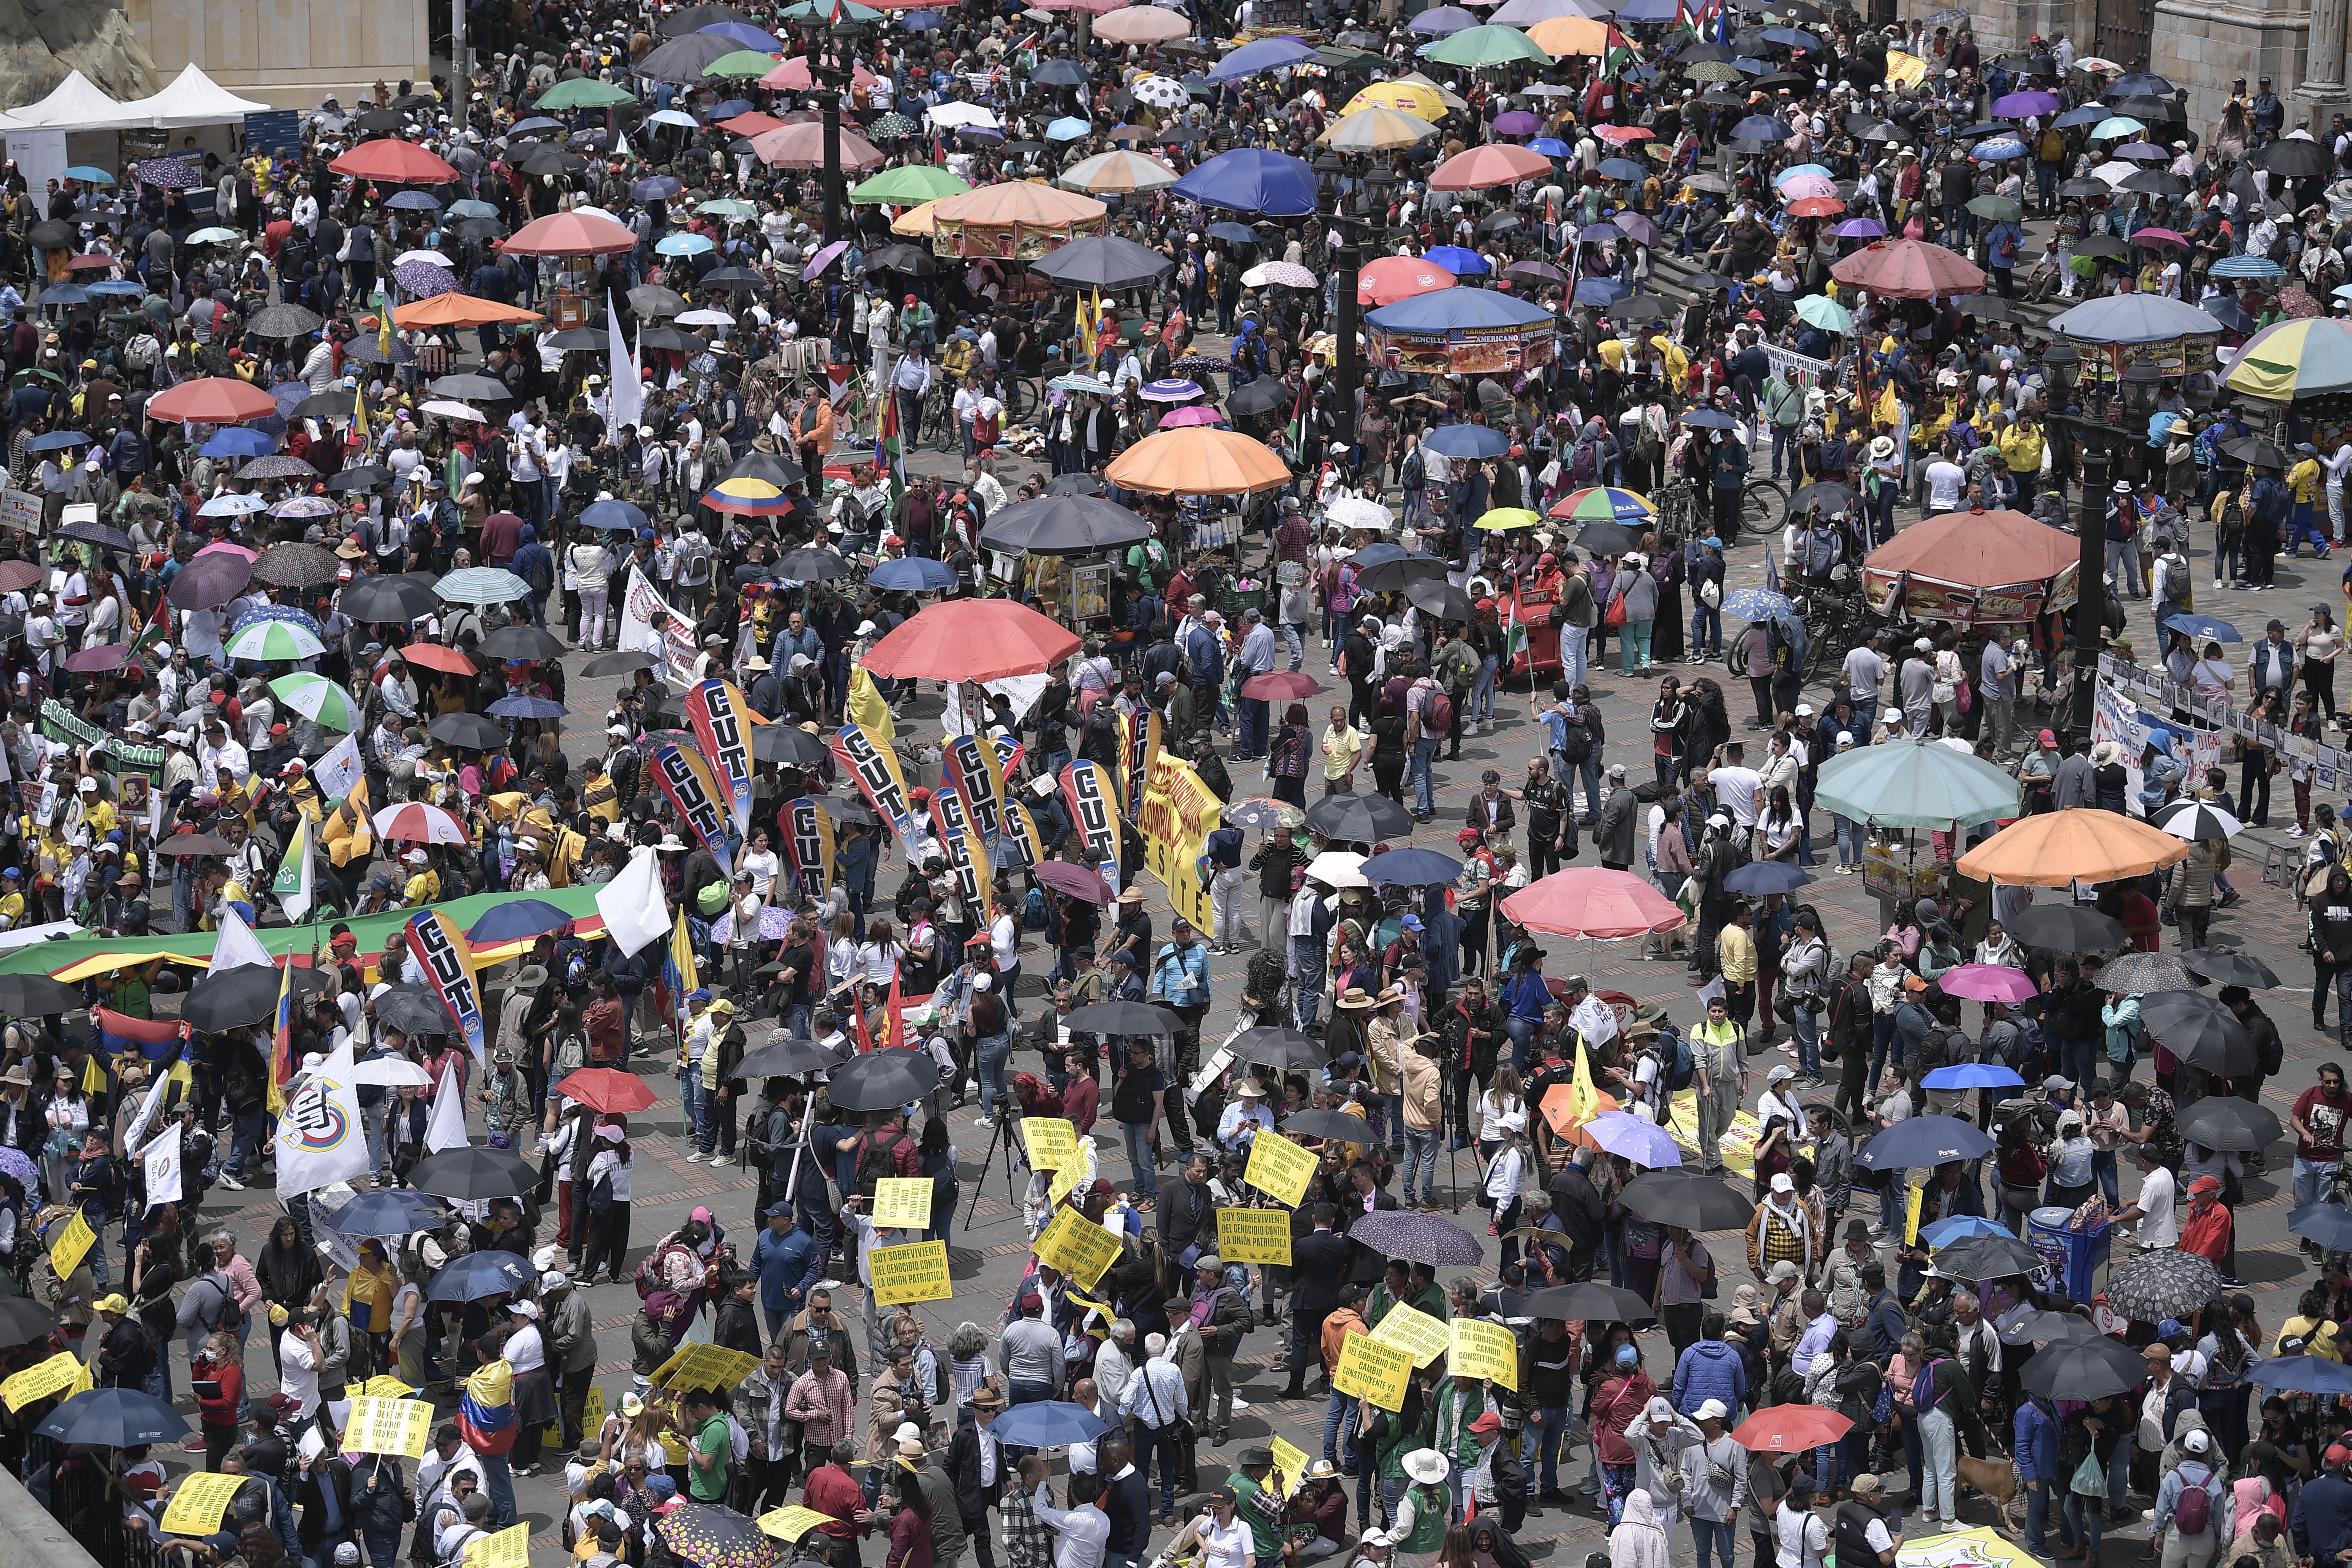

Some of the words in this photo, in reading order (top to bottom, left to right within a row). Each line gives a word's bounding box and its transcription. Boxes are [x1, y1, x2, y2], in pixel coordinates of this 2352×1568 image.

[133, 141, 156, 149] CAMBIO
[1475, 335, 1518, 343] AMERICANO
[1520, 331, 1533, 339] SUPER
[1533, 328, 1554, 337] ESPECIAL
[1758, 344, 1795, 364] OVIMIENTO
[13, 501, 24, 511] 13
[706, 685, 748, 781] CUT
[844, 729, 907, 822] CUT
[664, 751, 720, 838] CUT
[956, 741, 999, 834] CUT
[1074, 766, 1116, 865] CUT
[1137, 795, 1171, 847] OLOMBIA
[1004, 803, 1037, 868] CU
[792, 806, 826, 897] CUT
[417, 915, 474, 1017] CUT
[294, 1089, 329, 1130] CUT
[1036, 1148, 1073, 1156] CONSTITUYENTE
[1274, 1150, 1296, 1167] GOBIERNO
[1296, 1163, 1304, 1172] DEL
[1278, 1141, 1287, 1151] LAS
[1286, 1144, 1311, 1163] REFORMAS
[1938, 1148, 1959, 1157] Parker
[1261, 1163, 1291, 1186] CONSTITUYENTE
[1290, 1181, 1297, 1190] YA
[1273, 1160, 1290, 1174] CAMBIO
[890, 1181, 900, 1210] CONSTITUYENTE
[901, 1190, 909, 1206] CAMBIO
[910, 1188, 919, 1209] GOBIERNO
[918, 1195, 928, 1221] REFORMAS
[1222, 1212, 1234, 1222] SOY
[1236, 1213, 1286, 1225] SOBREVIVIENTE
[1071, 1218, 1082, 1228] POR
[1082, 1222, 1093, 1233] LAS
[1092, 1227, 1118, 1247] REFORMAS
[1222, 1224, 1233, 1233] DEL
[1233, 1225, 1264, 1235] GENOCIDIO
[1265, 1227, 1287, 1237] CONTRA
[1067, 1228, 1078, 1238] DEL
[1077, 1232, 1101, 1251] GOBIERNO
[1102, 1244, 1110, 1255] DEL
[1074, 1242, 1095, 1257] CAMBIO
[1223, 1236, 1231, 1245] LA
[1232, 1234, 1250, 1247] UNIÓN
[1252, 1234, 1287, 1249] PATRIÓTICA
[873, 1252, 887, 1263] SOY
[889, 1245, 941, 1261] SOBREVIVIENTE
[1056, 1244, 1094, 1269] CONSTITUYENTE
[1094, 1263, 1102, 1272] YA
[874, 1265, 886, 1276] DEL
[887, 1262, 920, 1274] GENOCIDIO
[920, 1258, 944, 1270] CONTRA
[877, 1278, 885, 1289] LA
[887, 1273, 907, 1287] UNIÓN
[909, 1269, 945, 1285] PATRIÓTICA
[1396, 1307, 1411, 1318] SOY
[1380, 1325, 1387, 1335] LA
[1388, 1329, 1407, 1343] UNIÓN
[1405, 1336, 1437, 1356] PATRIÓTICA
[1387, 1316, 1398, 1325] DEL
[1397, 1322, 1424, 1338] GENOCIDIO
[1423, 1333, 1446, 1349] CONTRA
[1459, 1331, 1471, 1340] DEL
[1473, 1334, 1503, 1348] GOBIERNO
[1505, 1344, 1513, 1353] DEL
[1473, 1324, 1485, 1333] LAS
[1486, 1327, 1514, 1344] REFORMAS
[1348, 1335, 1359, 1346] POR
[1360, 1339, 1372, 1350] LAS
[1372, 1343, 1406, 1364] REFORMAS
[1348, 1345, 1357, 1357] DEL
[1358, 1350, 1388, 1369] GOBIERNO
[1389, 1361, 1401, 1373] DEL
[1476, 1344, 1500, 1357] CAMBIO
[1358, 1361, 1383, 1377] CAMBIO
[1458, 1351, 1505, 1368] CONSTITUYENTE
[1505, 1364, 1512, 1372] YA
[18, 1361, 68, 1385] CONSTITUYENTE
[29, 1374, 55, 1387] CAMBIO
[1343, 1366, 1387, 1390] CONSTITUYENTE
[1387, 1383, 1395, 1393] YA
[29, 1376, 61, 1393] GOBIERNO
[15, 1391, 27, 1400] DEL
[16, 1387, 51, 1406] REFORMAS
[182, 1475, 214, 1512] CONSTITUYENTE
[196, 1485, 214, 1506] CAMBIO
[204, 1483, 226, 1511] GOBIERNO
[223, 1484, 236, 1493] LAS
[199, 1513, 209, 1524] DEL
[208, 1494, 229, 1528] REFORMAS
